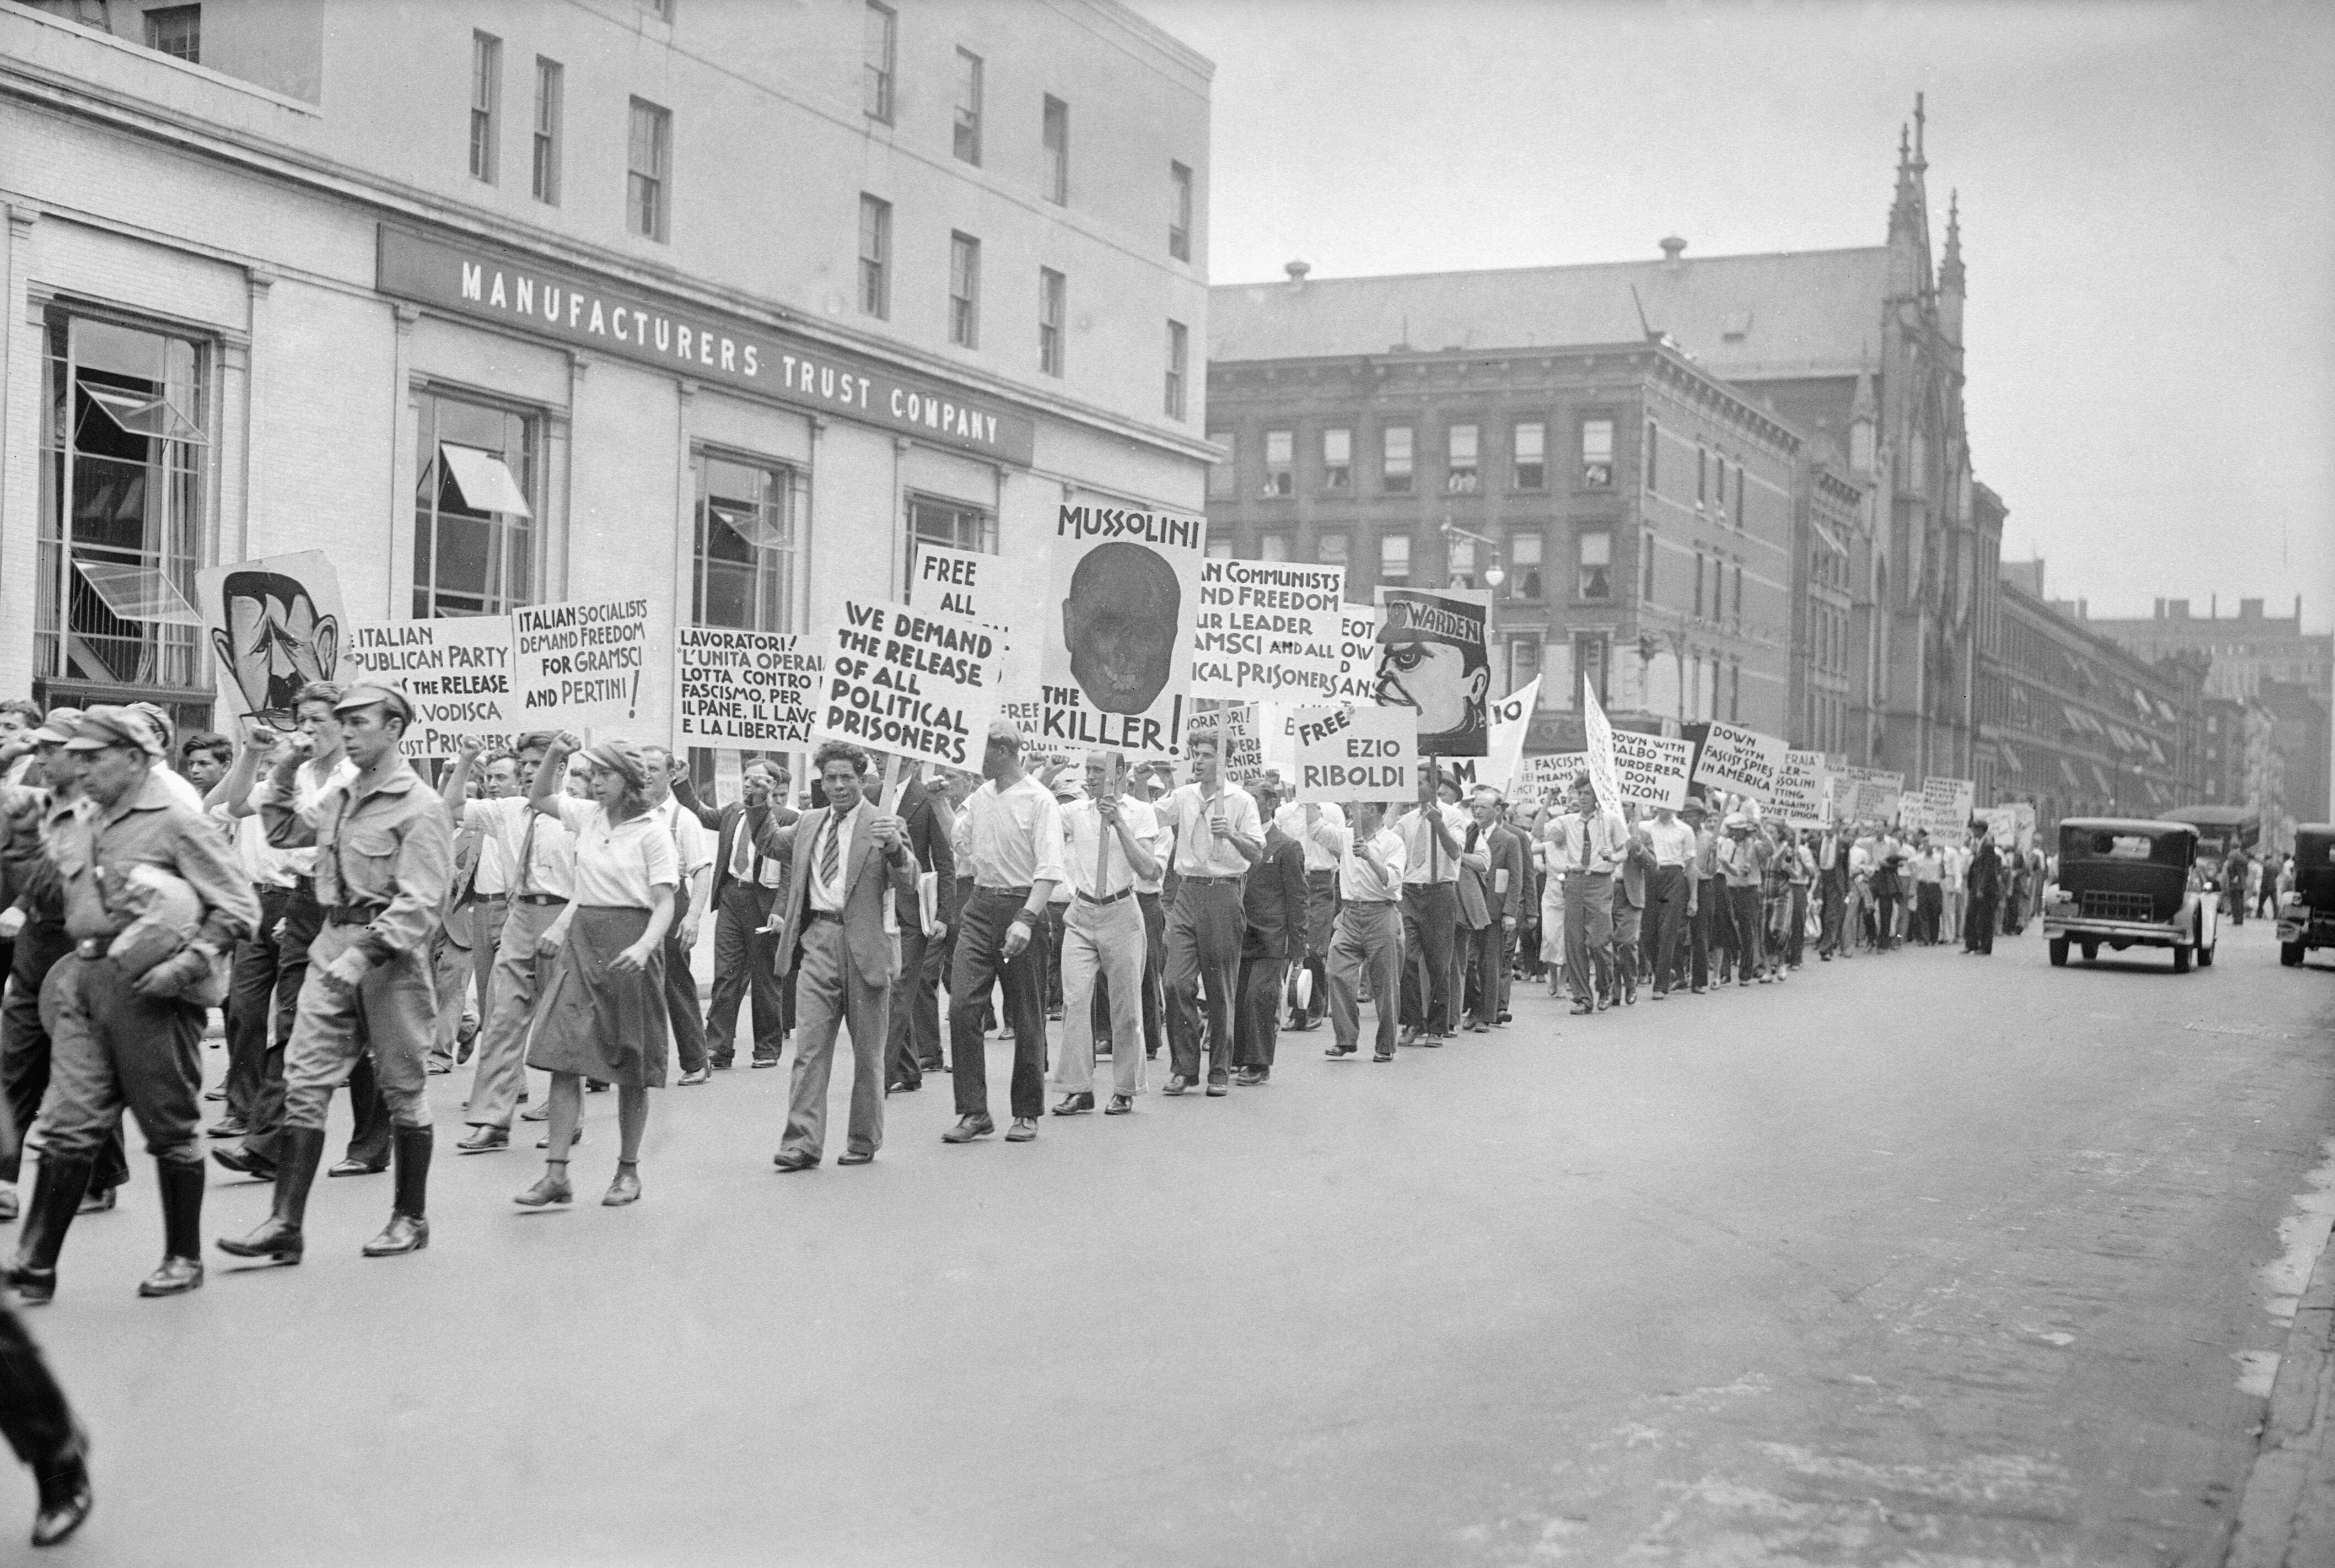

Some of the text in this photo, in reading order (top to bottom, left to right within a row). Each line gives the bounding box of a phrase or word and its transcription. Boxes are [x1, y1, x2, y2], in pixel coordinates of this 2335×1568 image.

[462, 261, 997, 443] MANUFACTURERS TRUST COMPANY
[1058, 504, 1199, 549] MUSSOLINI
[923, 556, 977, 586] FREE
[1226, 561, 1340, 592] COMMUNISTS
[940, 592, 976, 616] ALL
[1239, 586, 1339, 613] FREEDOM
[519, 599, 647, 633] ITALIAN SOCIALISTS
[1230, 612, 1313, 635] LEADER
[1406, 601, 1479, 642] WARDEN
[359, 627, 433, 648] ITALIAN
[520, 622, 645, 654] DEMAND FREEDOM
[846, 600, 885, 632] WE
[894, 613, 992, 659] DEMAND
[681, 630, 798, 652] LAVORATORI!
[1269, 640, 1303, 655] AND
[1304, 643, 1335, 659] ALL
[448, 645, 508, 668] PARTY
[542, 646, 642, 677] FOR GRAMSCI
[756, 653, 826, 672] OPERAI
[838, 628, 982, 687] THE RELEASE
[413, 681, 439, 694] THE
[441, 674, 509, 694] RELEASE
[681, 667, 733, 684] LOTTA
[743, 670, 812, 689] CONTRO
[835, 656, 921, 696] OF ALL
[1237, 661, 1338, 698] PRISONERS
[526, 688, 557, 709] AND
[681, 683, 802, 705] FASCISMO, PER
[1041, 685, 1080, 707] THE
[422, 701, 502, 722] VODISCA
[682, 700, 696, 715] IL
[753, 704, 768, 720] IL
[831, 678, 969, 735] POLITICAL
[682, 718, 693, 734] E
[701, 719, 723, 736] LA
[827, 705, 966, 764] PRISONERS
[1043, 694, 1183, 756] KILLER!
[1299, 710, 1351, 747] FREE
[1653, 740, 1686, 753] WITH
[1713, 726, 1756, 747] DOWN
[1346, 739, 1400, 758] EZIO
[1664, 753, 1686, 766] THE
[1733, 745, 1764, 761] WITH
[1535, 756, 1585, 771] FASCISM
[1704, 745, 1774, 778] FASCIST SPIES
[1304, 765, 1405, 788] RIBOLDI
[1537, 771, 1573, 783] MEANS
[1626, 770, 1656, 785] DON
[1701, 762, 1770, 791] IN AMERICA
[1617, 782, 1670, 801] NZONI
[1779, 799, 1817, 812] AGAINST
[1790, 809, 1820, 821] UNION
